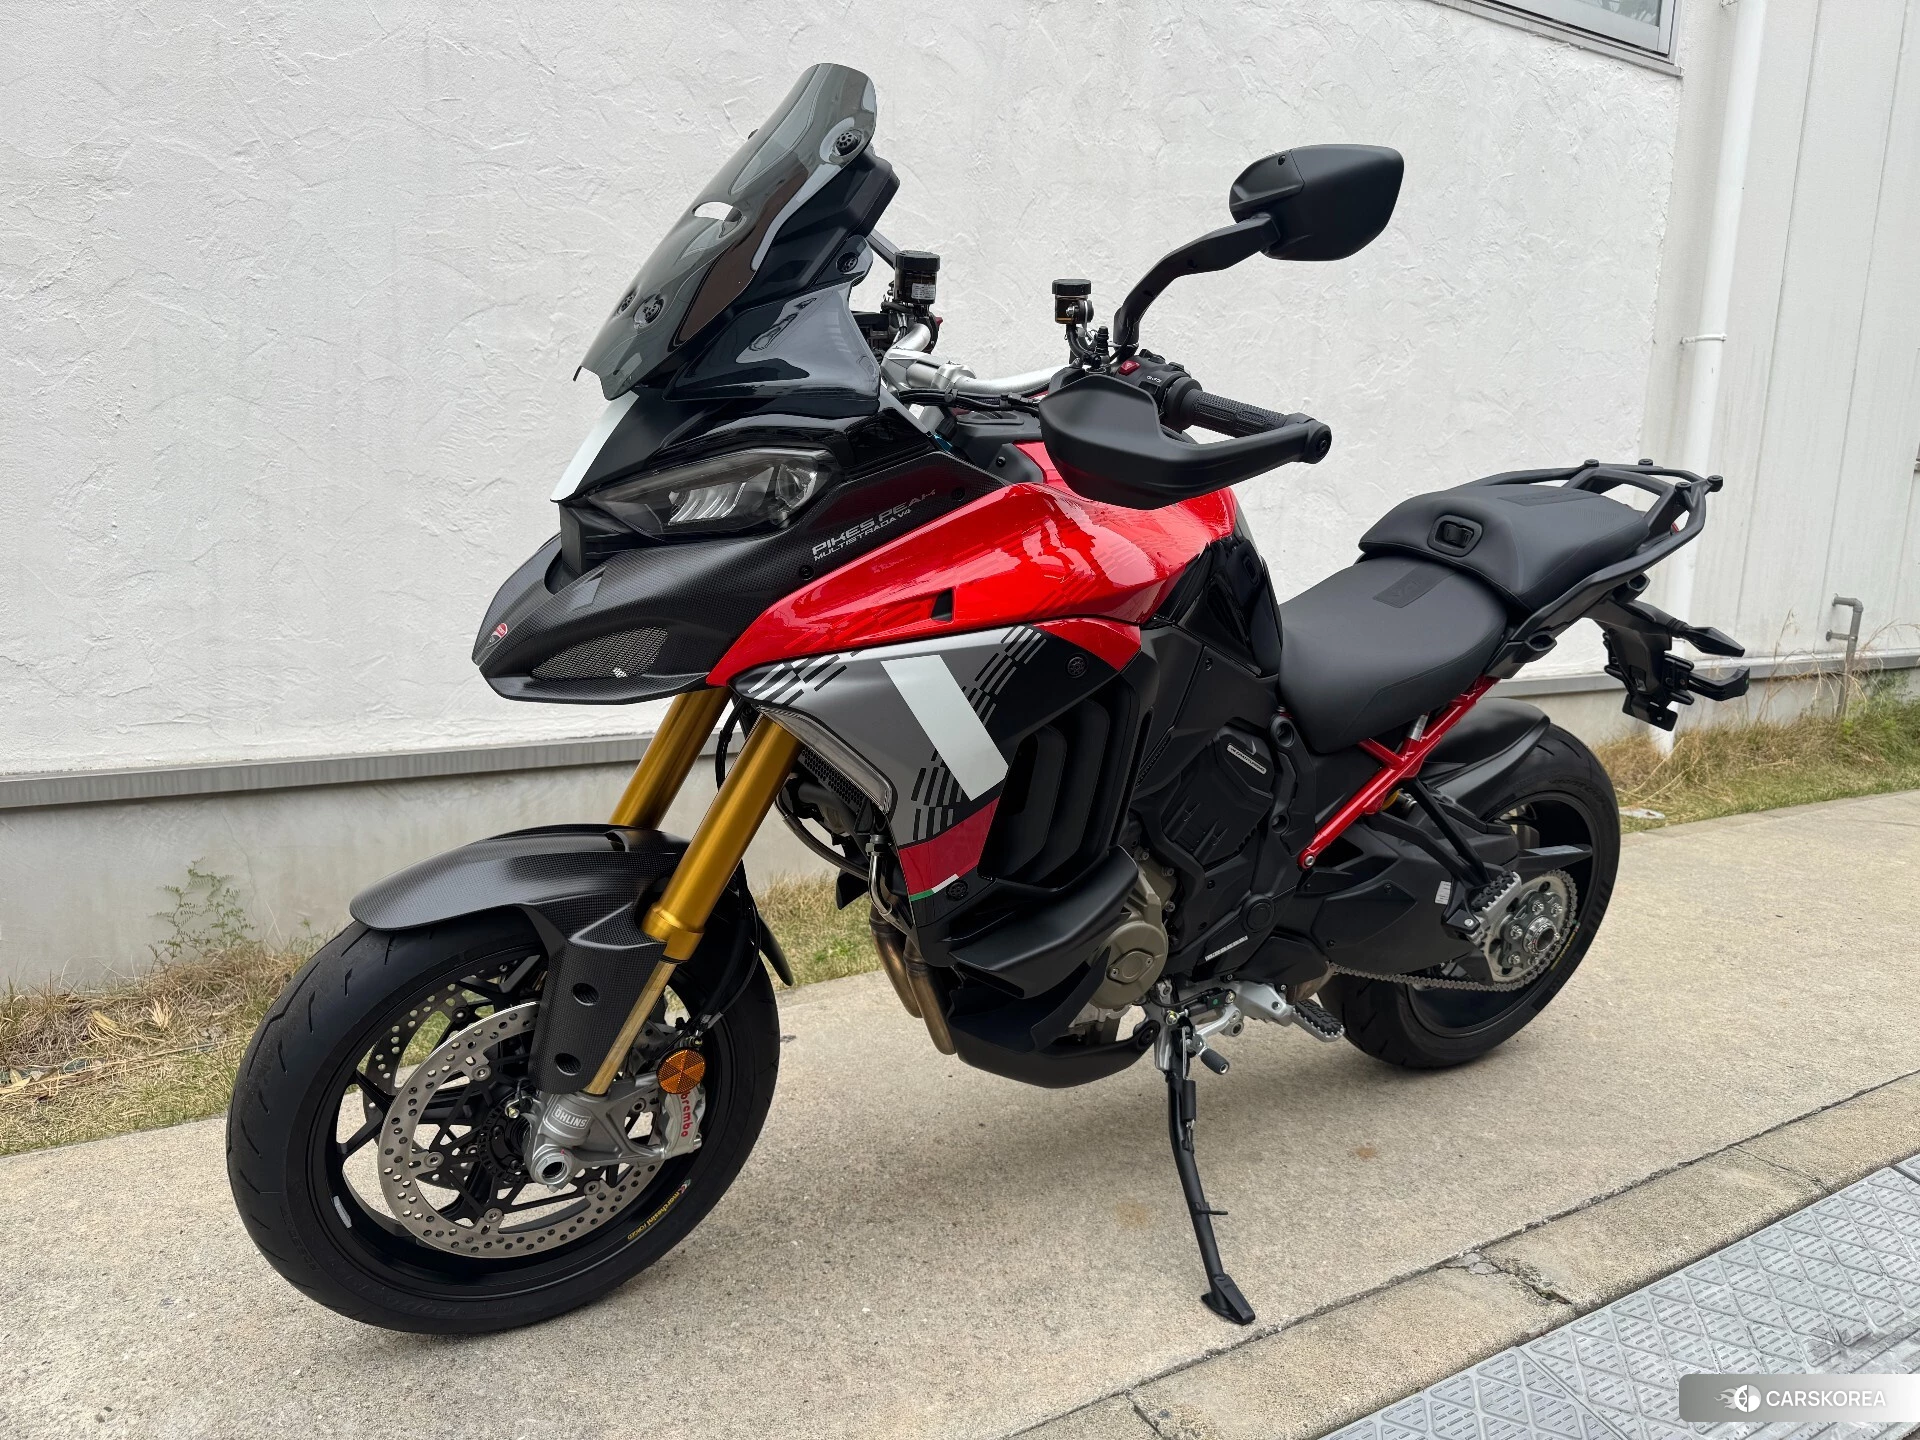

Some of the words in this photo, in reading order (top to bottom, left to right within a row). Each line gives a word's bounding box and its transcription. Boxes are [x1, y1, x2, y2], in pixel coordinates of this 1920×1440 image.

[811, 518, 875, 556] PIKES
[878, 489, 936, 522] PEAK
[813, 518, 897, 562] MULTISTRADA
[897, 508, 912, 519] V4
[554, 1105, 588, 1128] ÖHLINS
[680, 1091, 693, 1138] brembo
